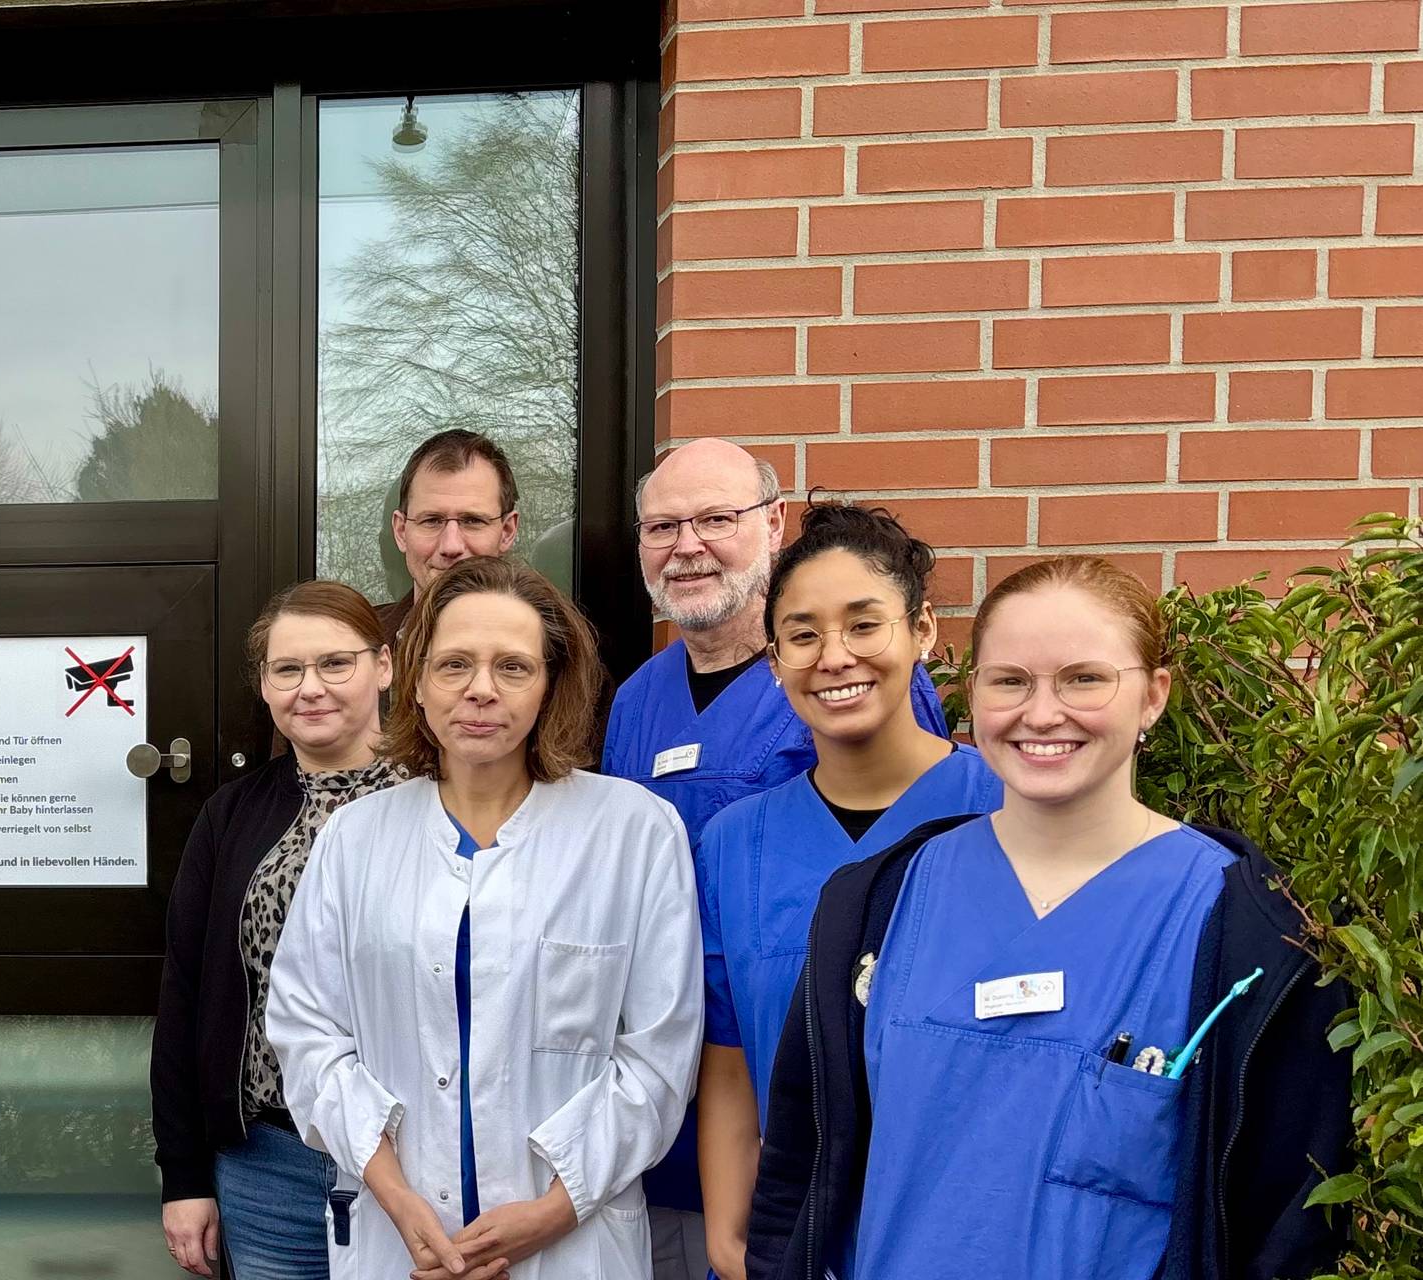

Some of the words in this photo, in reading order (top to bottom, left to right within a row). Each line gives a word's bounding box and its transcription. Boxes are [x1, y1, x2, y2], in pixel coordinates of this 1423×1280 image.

[13, 736, 28, 746] Tür
[30, 735, 63, 746] öffnen
[11, 793, 47, 803] können
[49, 794, 77, 804] gerne
[9, 805, 34, 817] Baby
[35, 804, 95, 815] hinterlassen
[43, 825, 62, 834] von
[63, 823, 93, 834] selbst
[19, 856, 31, 867] in
[32, 856, 91, 867] liebevollen
[92, 855, 138, 867] Händen.
